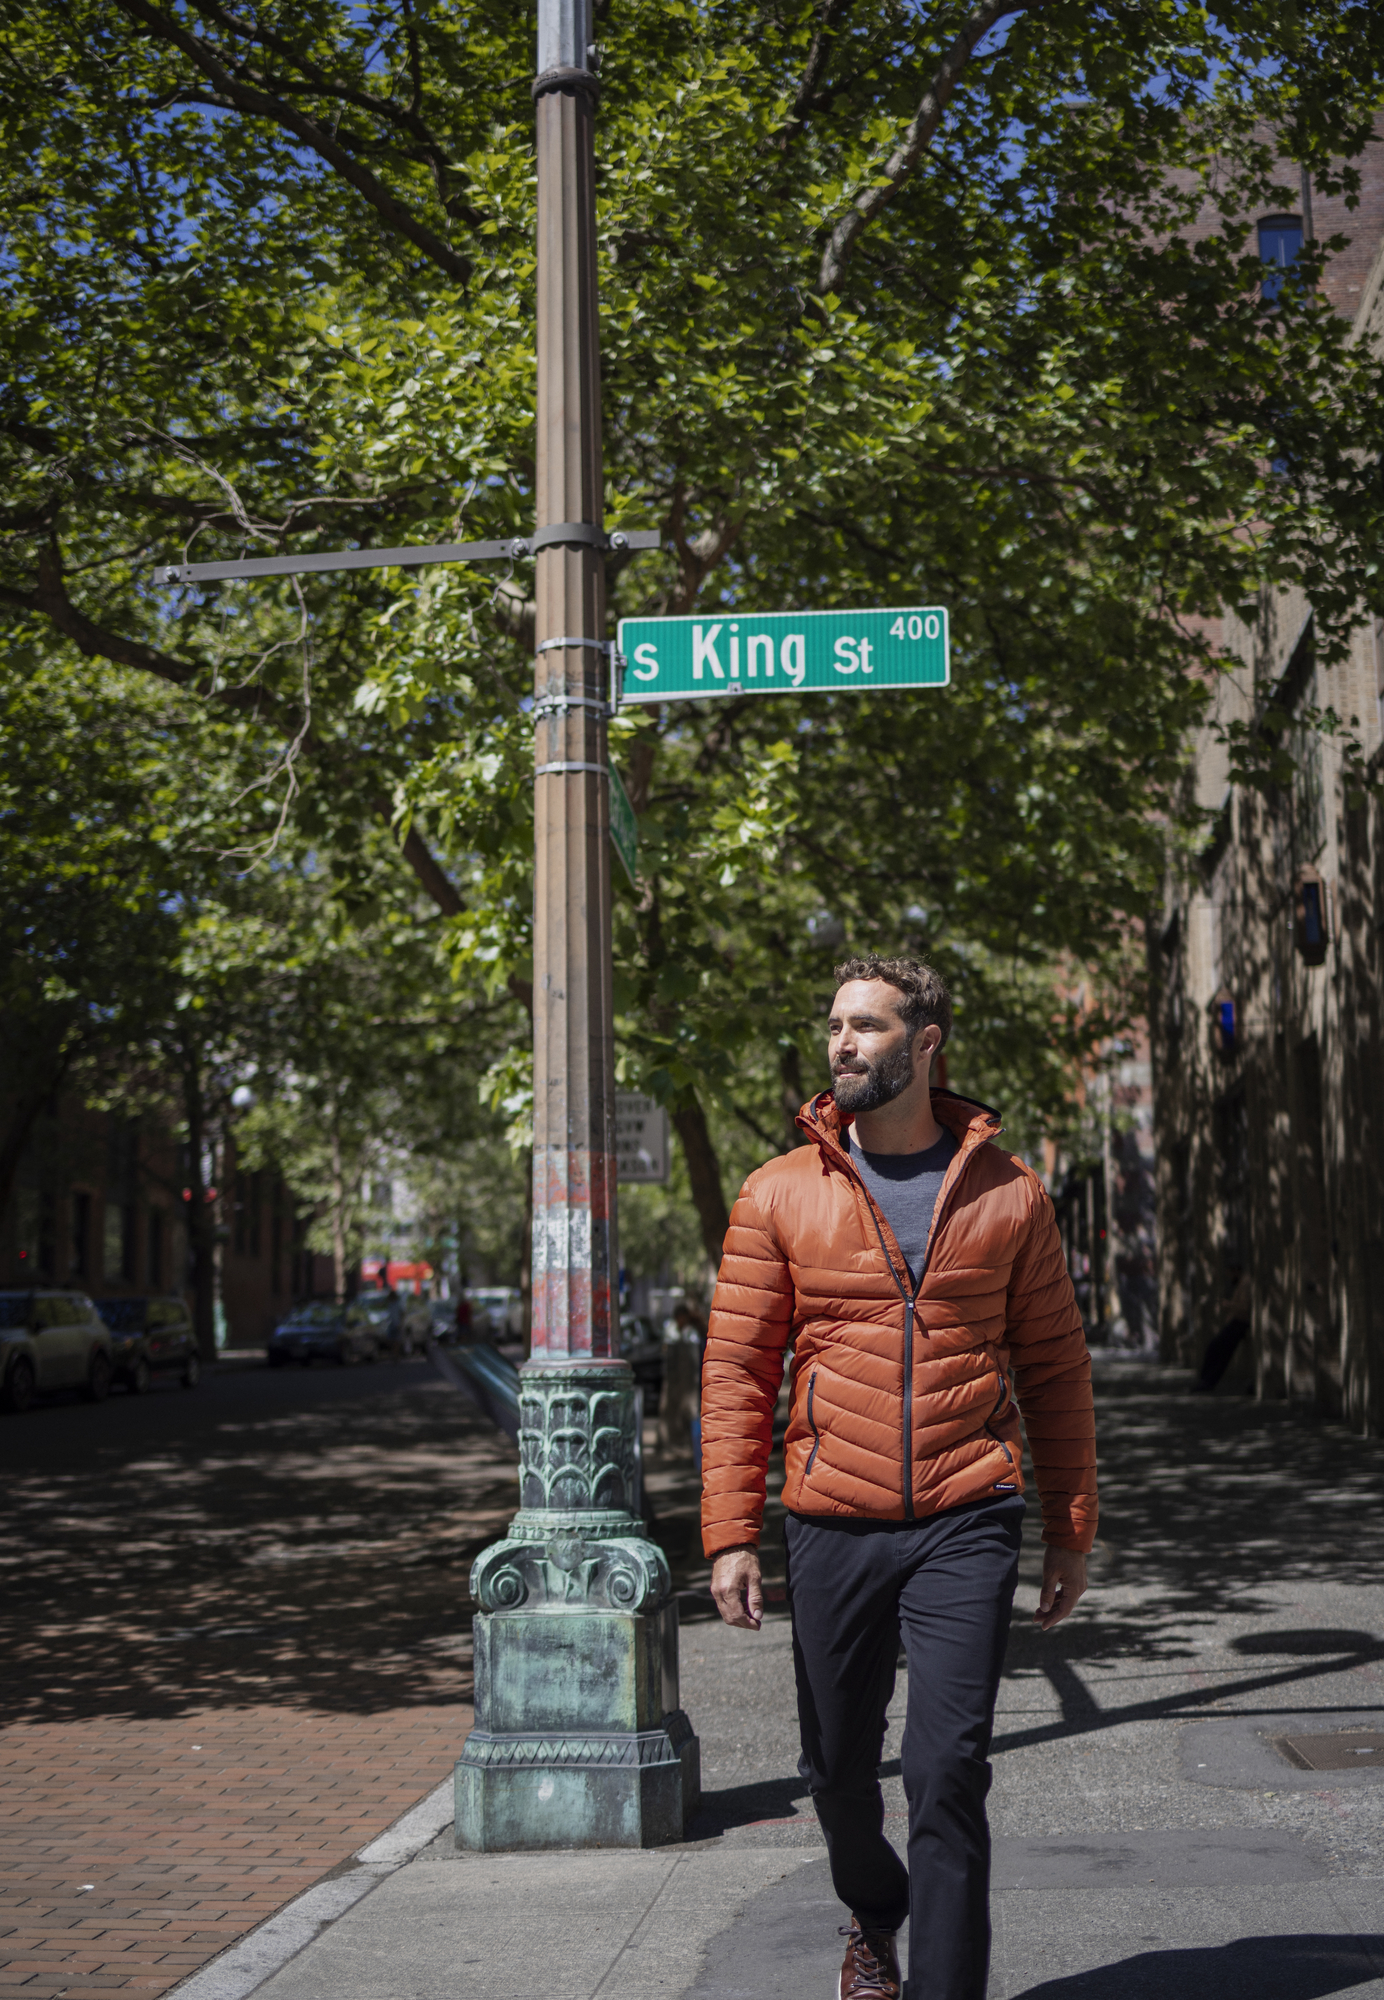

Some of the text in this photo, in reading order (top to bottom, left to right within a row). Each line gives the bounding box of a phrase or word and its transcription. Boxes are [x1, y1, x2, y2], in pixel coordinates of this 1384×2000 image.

[889, 614, 940, 640] 400
[632, 623, 874, 687] S King St
